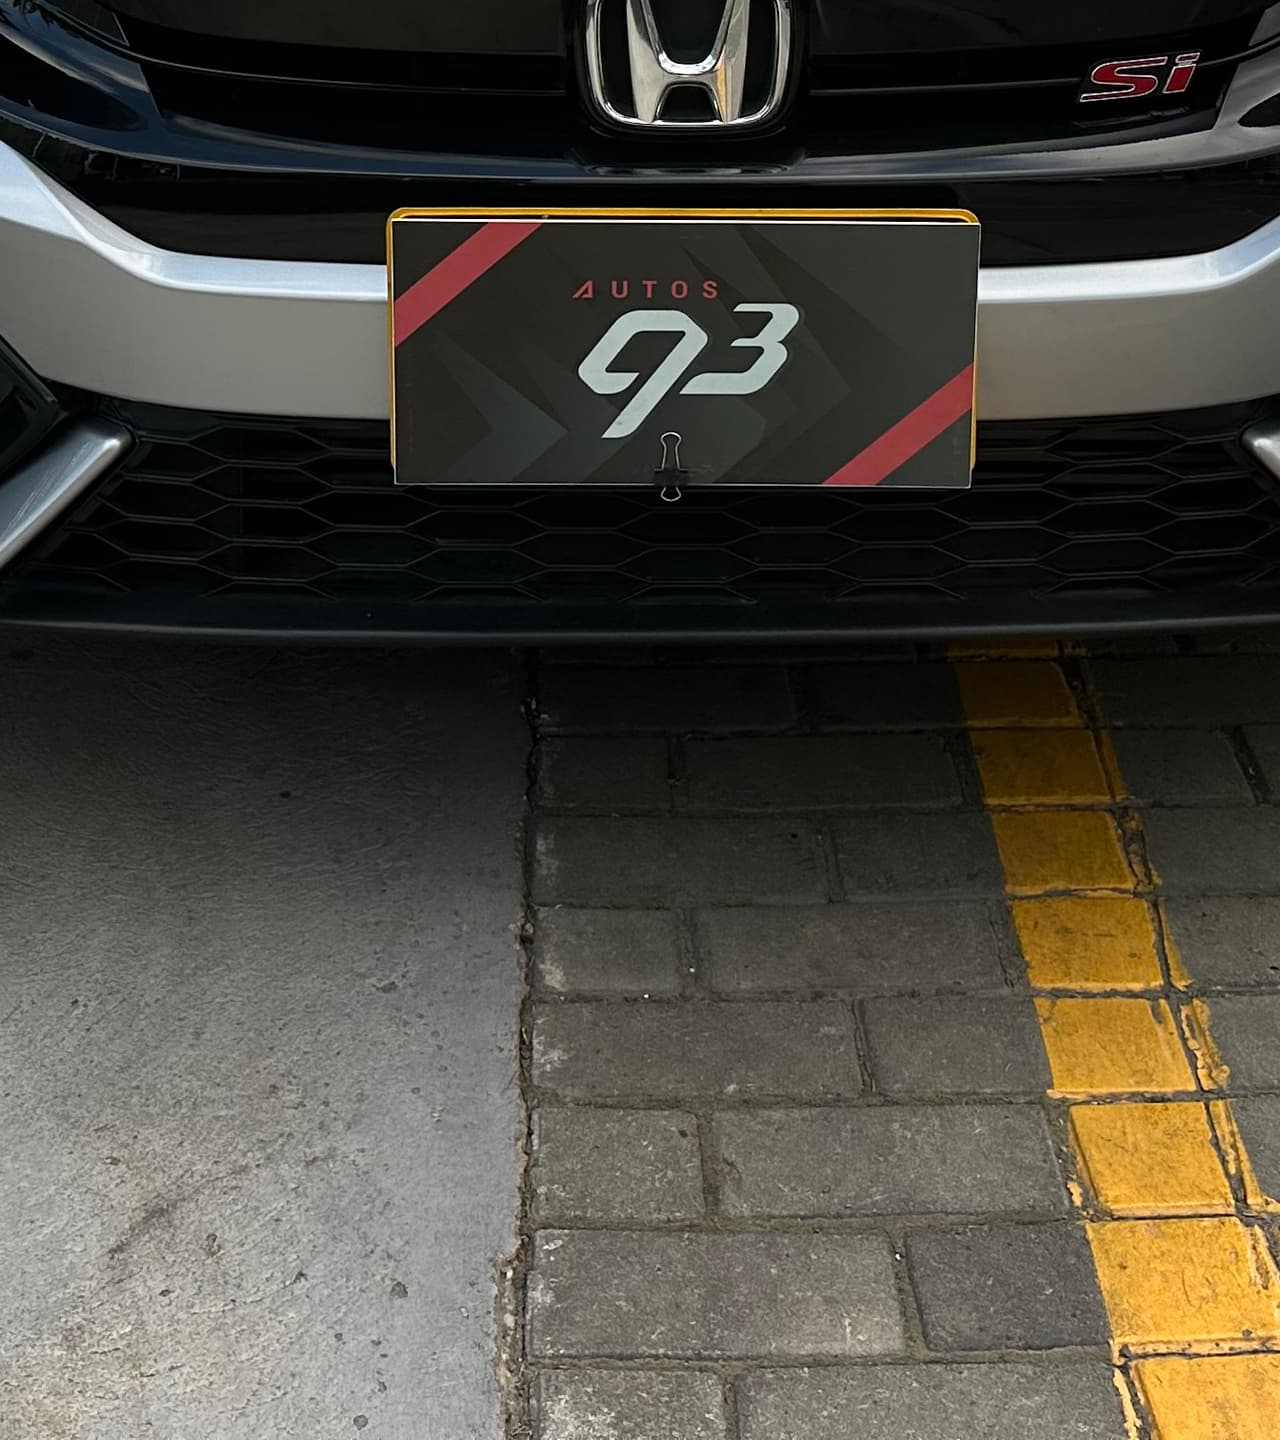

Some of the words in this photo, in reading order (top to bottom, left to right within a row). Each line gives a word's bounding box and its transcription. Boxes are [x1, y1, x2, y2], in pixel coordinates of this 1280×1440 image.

[1080, 52, 1201, 103] Si
[572, 279, 719, 300] AUTOS
[577, 302, 800, 439] 93
